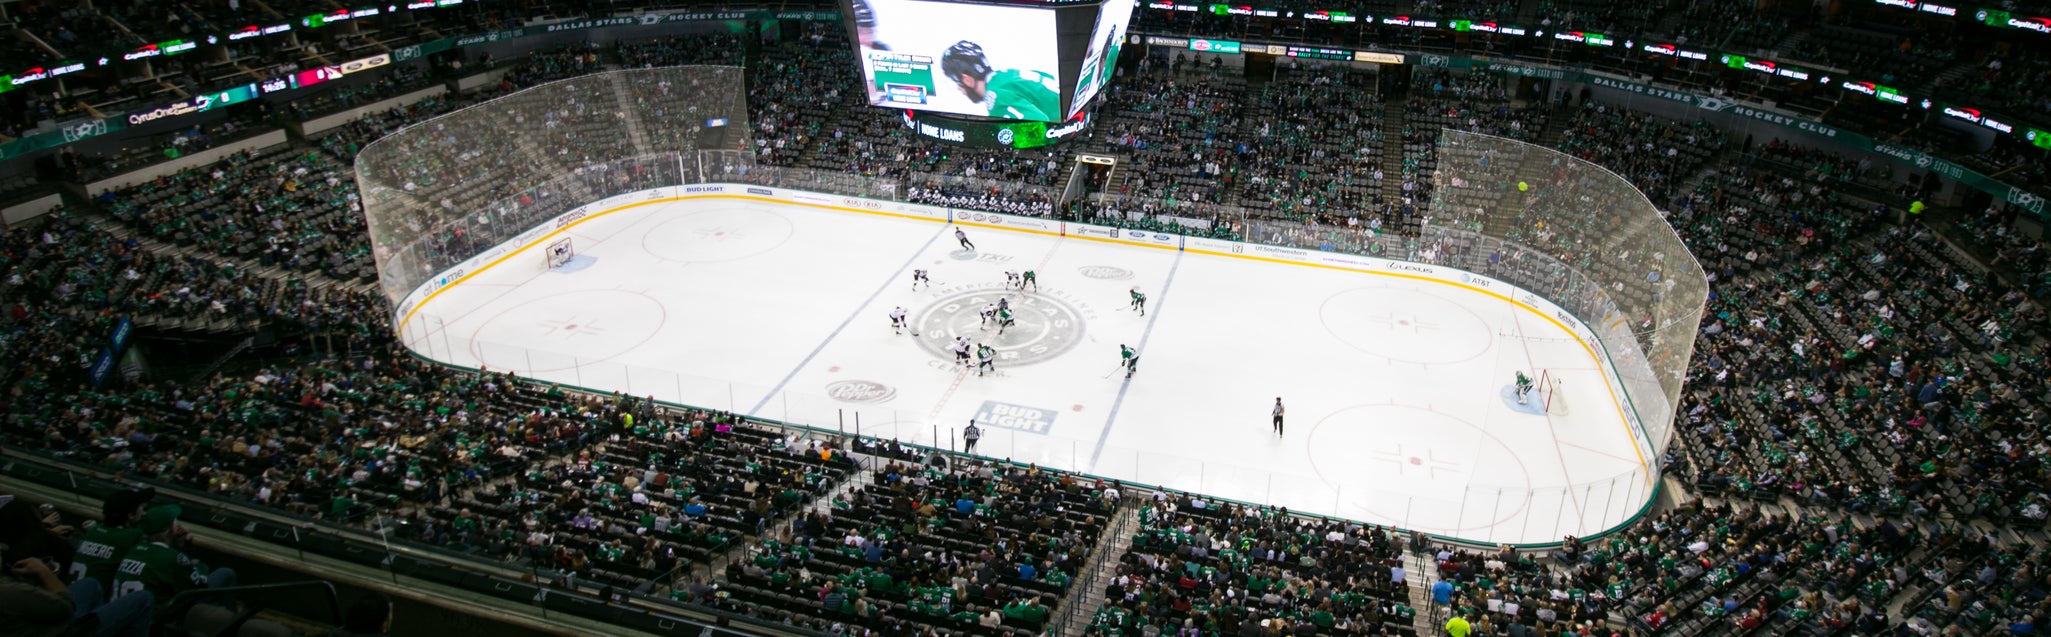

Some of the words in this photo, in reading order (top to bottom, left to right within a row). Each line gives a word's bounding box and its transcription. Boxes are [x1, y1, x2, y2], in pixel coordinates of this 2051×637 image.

[547, 22, 593, 32] DALLAS
[596, 17, 632, 27] STARS
[1594, 77, 1643, 94] DALLAS
[1648, 86, 1691, 102] STARS
[1734, 107, 1793, 127] HOCKEY
[1799, 122, 1836, 137] CLUB
[921, 123, 940, 139] HOME
[940, 128, 965, 143] LOANS
[1874, 145, 1912, 161] STARS
[1399, 265, 1433, 274] LEXUS
[423, 281, 433, 297] at
[1471, 277, 1490, 288] AT&T
[999, 404, 1042, 420] BUD
[1621, 397, 1641, 440] GEICO
[980, 411, 1049, 433] LIGHT
